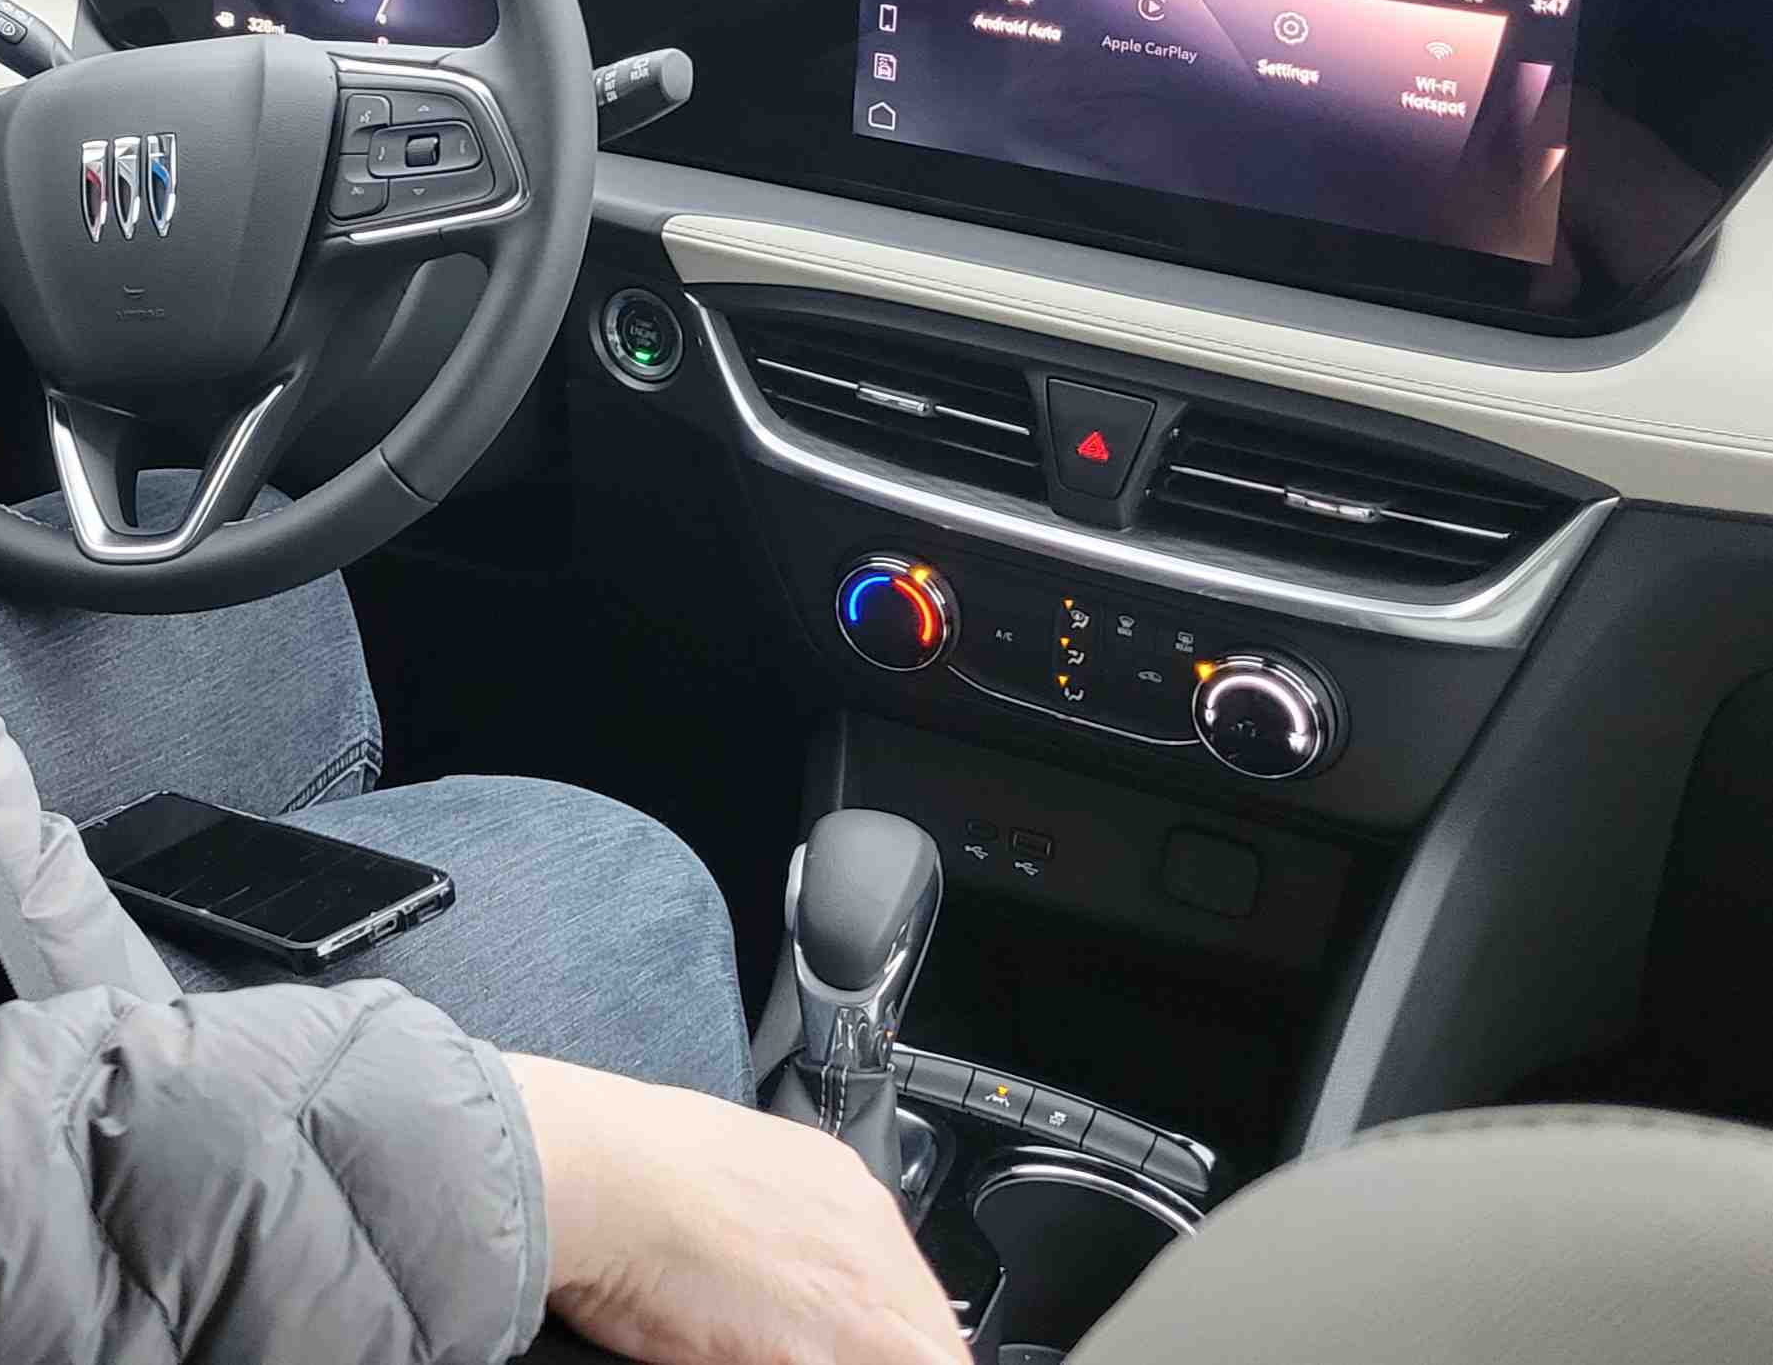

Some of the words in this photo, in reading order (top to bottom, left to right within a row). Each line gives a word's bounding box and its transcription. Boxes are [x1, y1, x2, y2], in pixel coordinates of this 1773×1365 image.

[973, 13, 1028, 36] Android
[1028, 21, 1062, 42] Auto
[1101, 34, 1142, 53] Apple
[1144, 40, 1197, 65] CarPlay
[1257, 58, 1320, 84] Settings
[1401, 91, 1467, 119] Hotspot
[995, 629, 1013, 642] A/C
